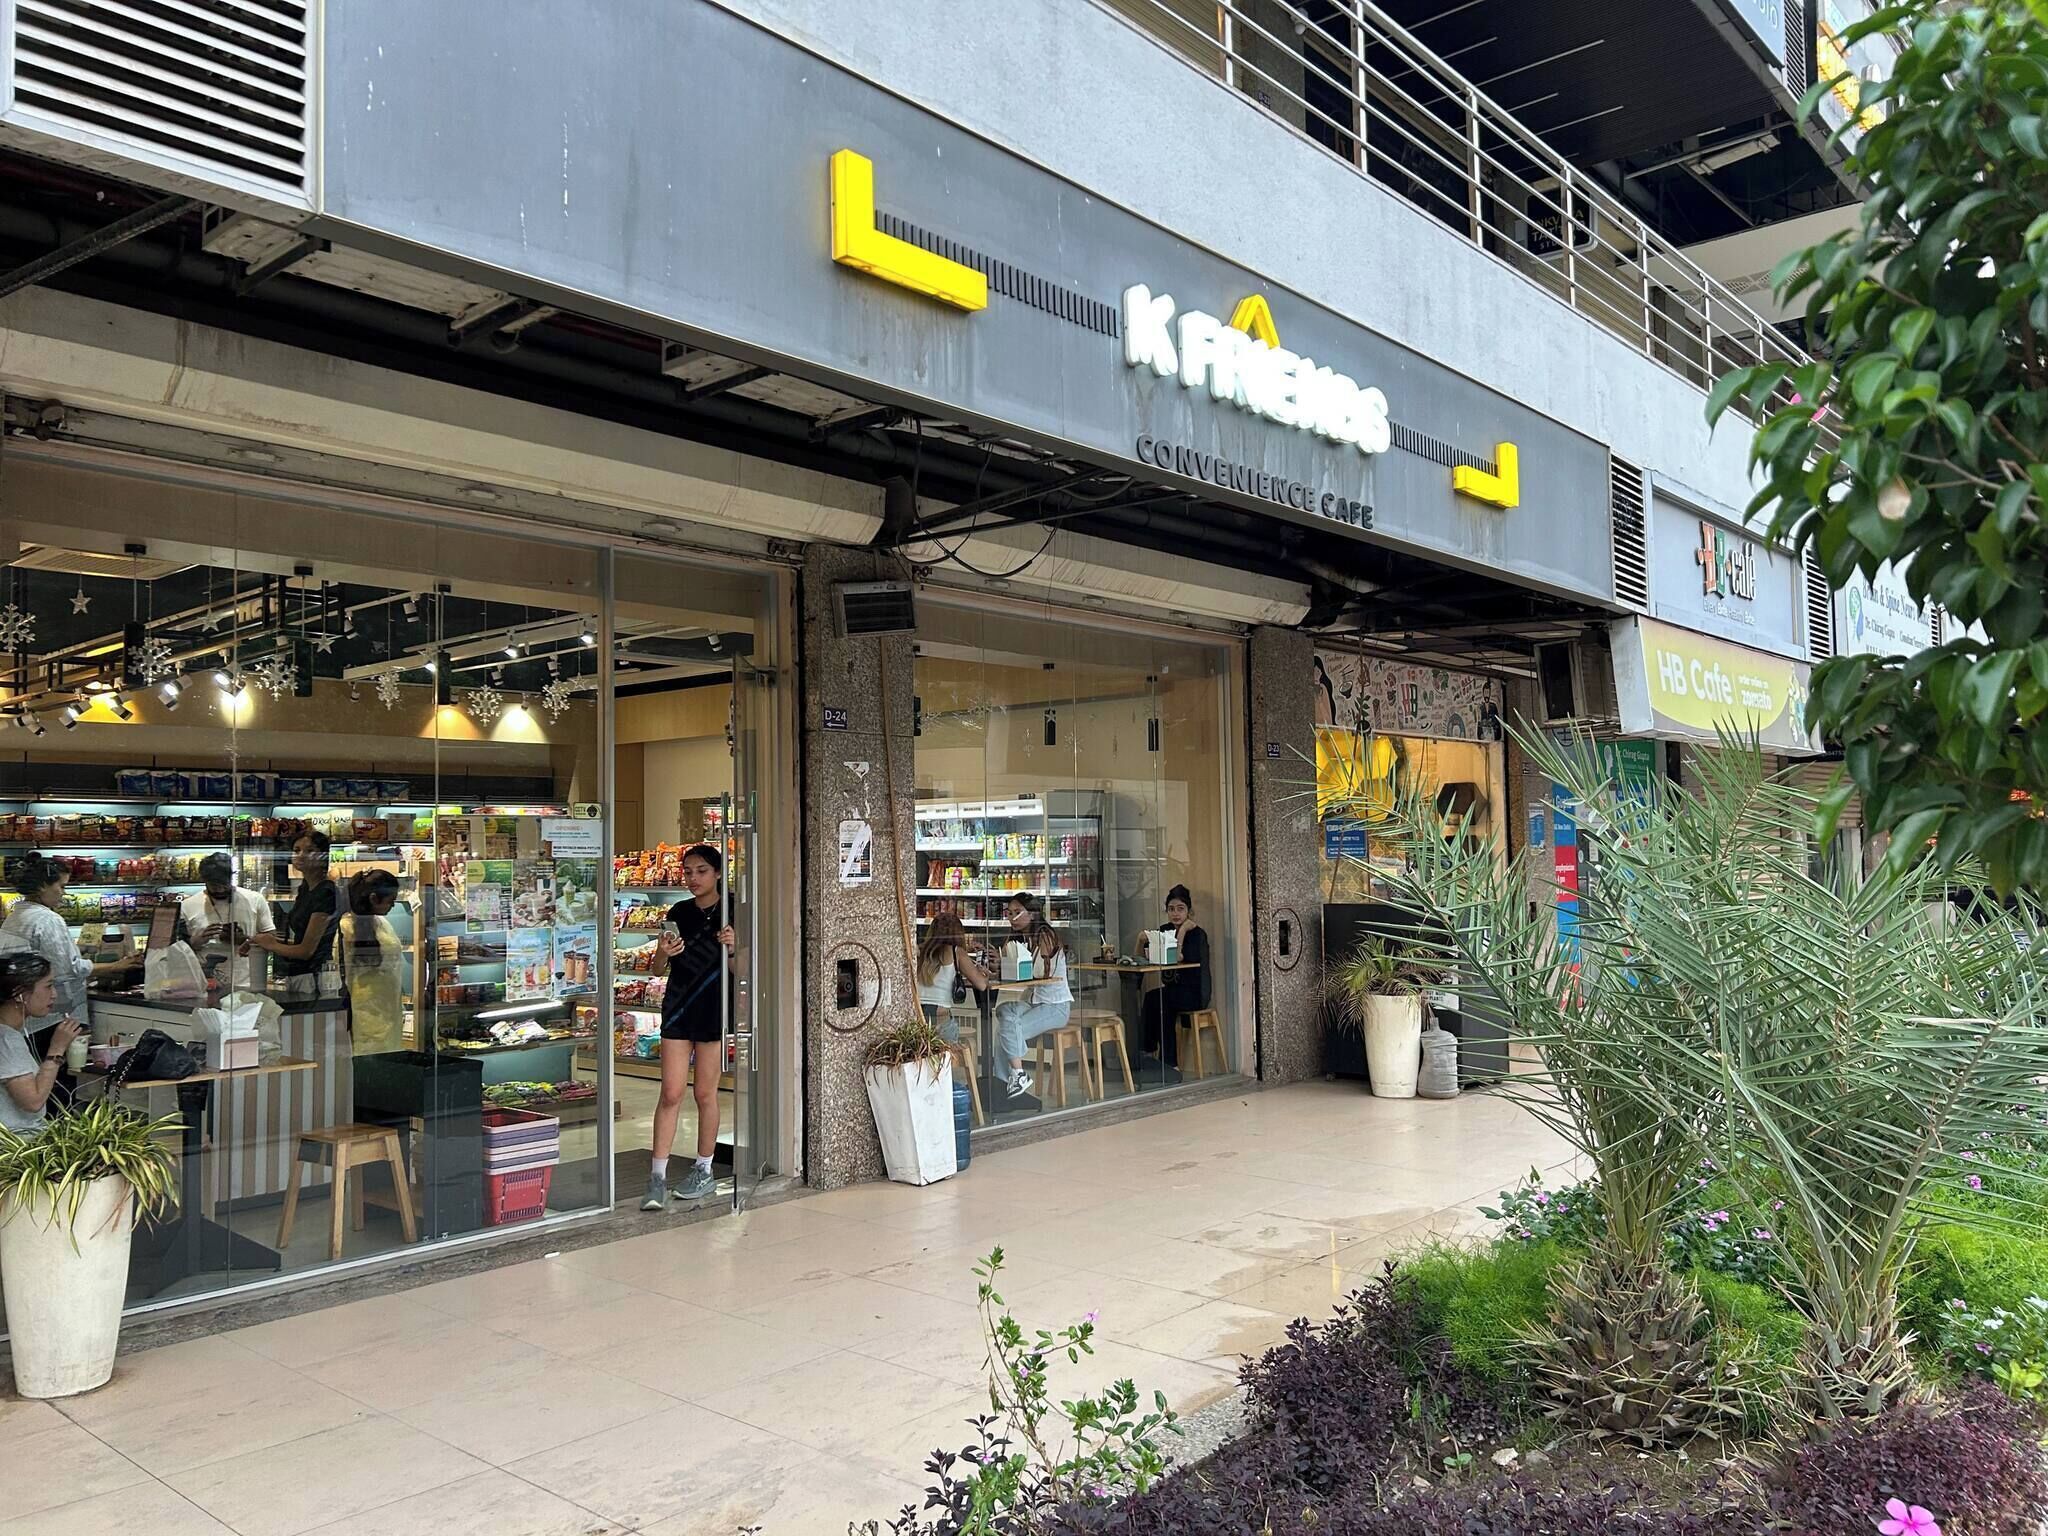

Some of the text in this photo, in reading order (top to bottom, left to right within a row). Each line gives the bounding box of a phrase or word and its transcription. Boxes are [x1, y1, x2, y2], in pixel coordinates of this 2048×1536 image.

[1136, 433, 1374, 530] CONVENIENCE CAFE
[1656, 649, 1734, 705] HB Cafe
[824, 709, 847, 722] D-24
[1267, 743, 1280, 753] D-23
